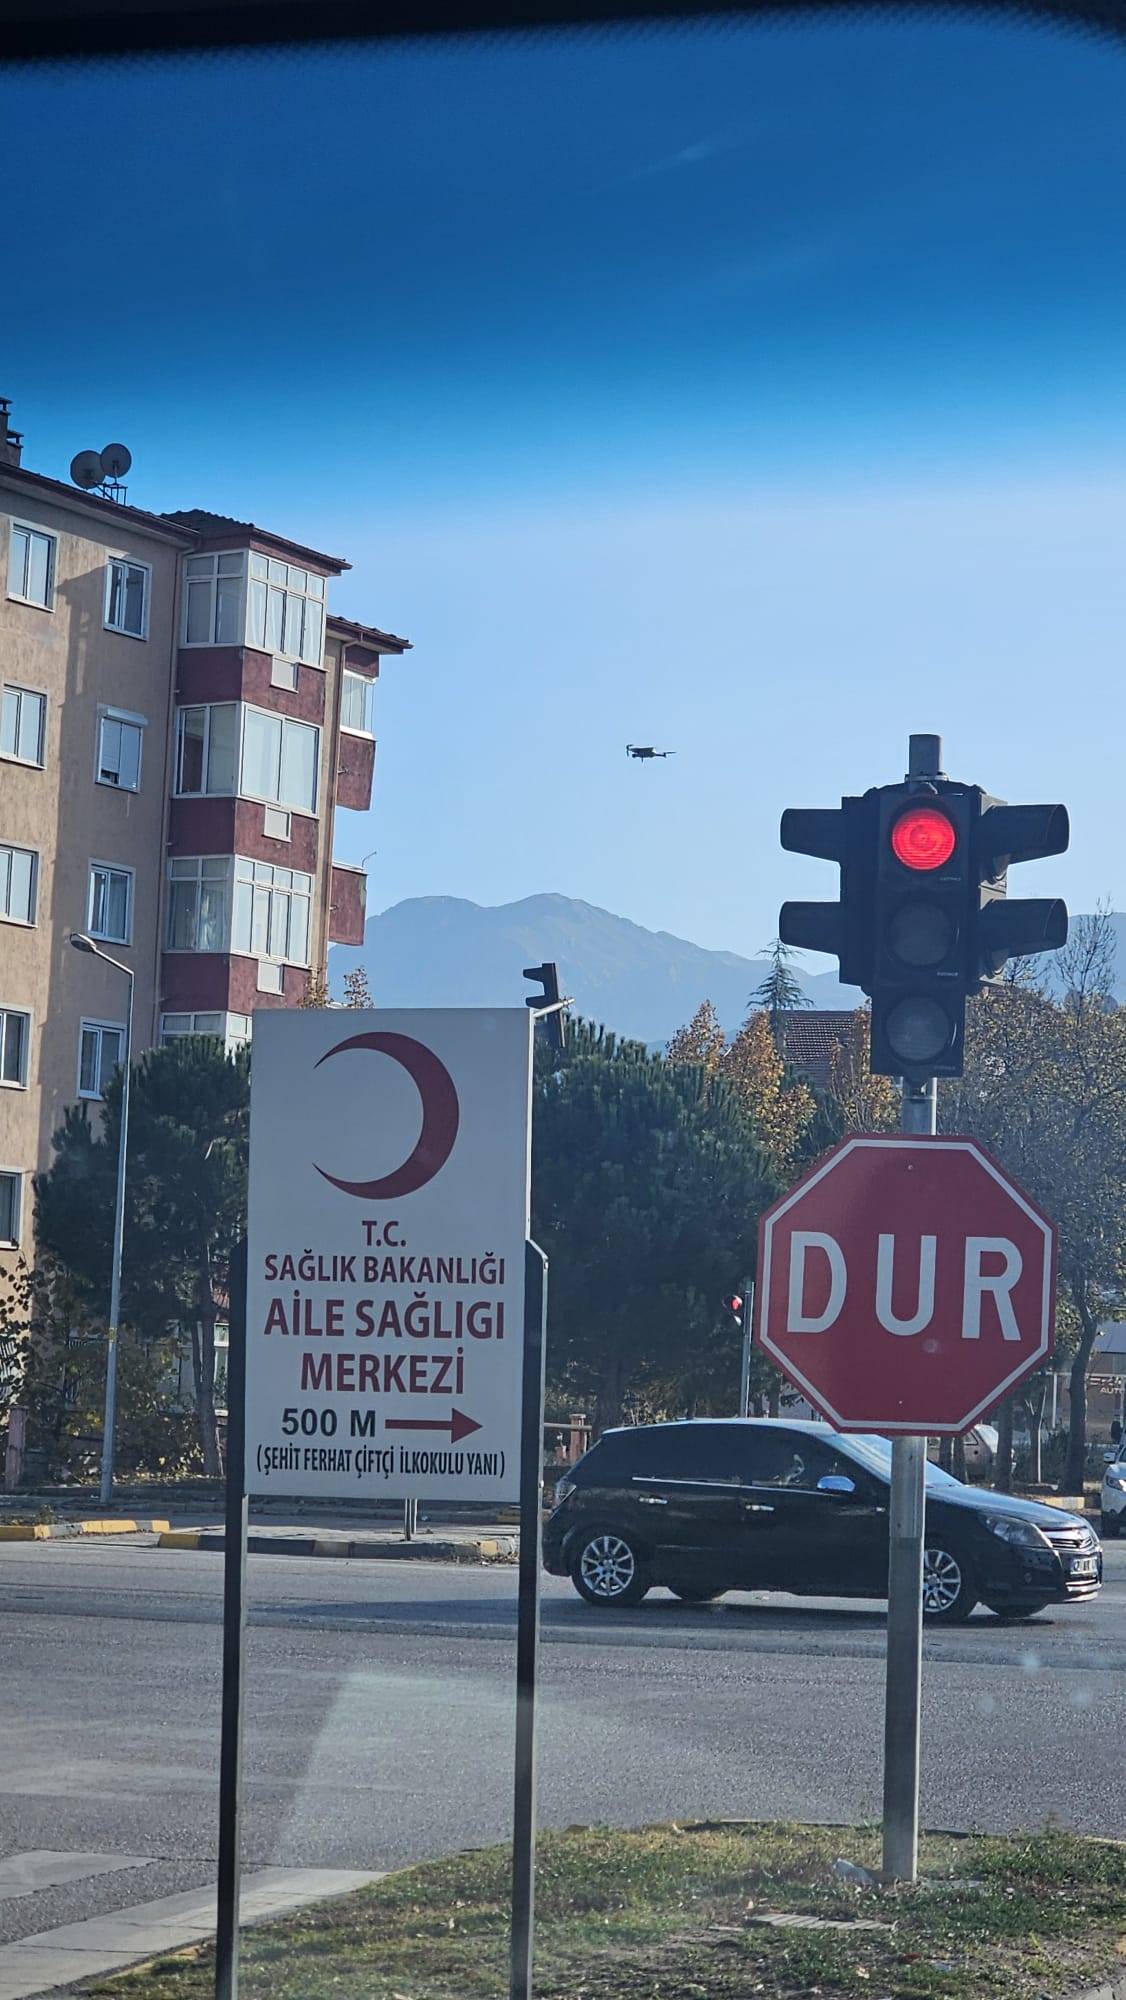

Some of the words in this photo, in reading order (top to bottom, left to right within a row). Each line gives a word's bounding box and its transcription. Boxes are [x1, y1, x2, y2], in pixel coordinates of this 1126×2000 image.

[361, 1220, 407, 1247] T.C.
[264, 1248, 357, 1283] SAĞLIK
[363, 1251, 505, 1285] BAKANLIĞI
[786, 1230, 1024, 1342] DUR
[263, 1289, 345, 1337] AİLE
[355, 1291, 504, 1340] SAĞLIGI
[300, 1346, 464, 1395] MERKEZİ
[281, 1407, 338, 1438] 500
[350, 1409, 376, 1438] M
[303, 1447, 351, 1473] FERHAT
[355, 1444, 395, 1479] ÇİFTÇİ
[399, 1445, 464, 1475] İLKOKULU
